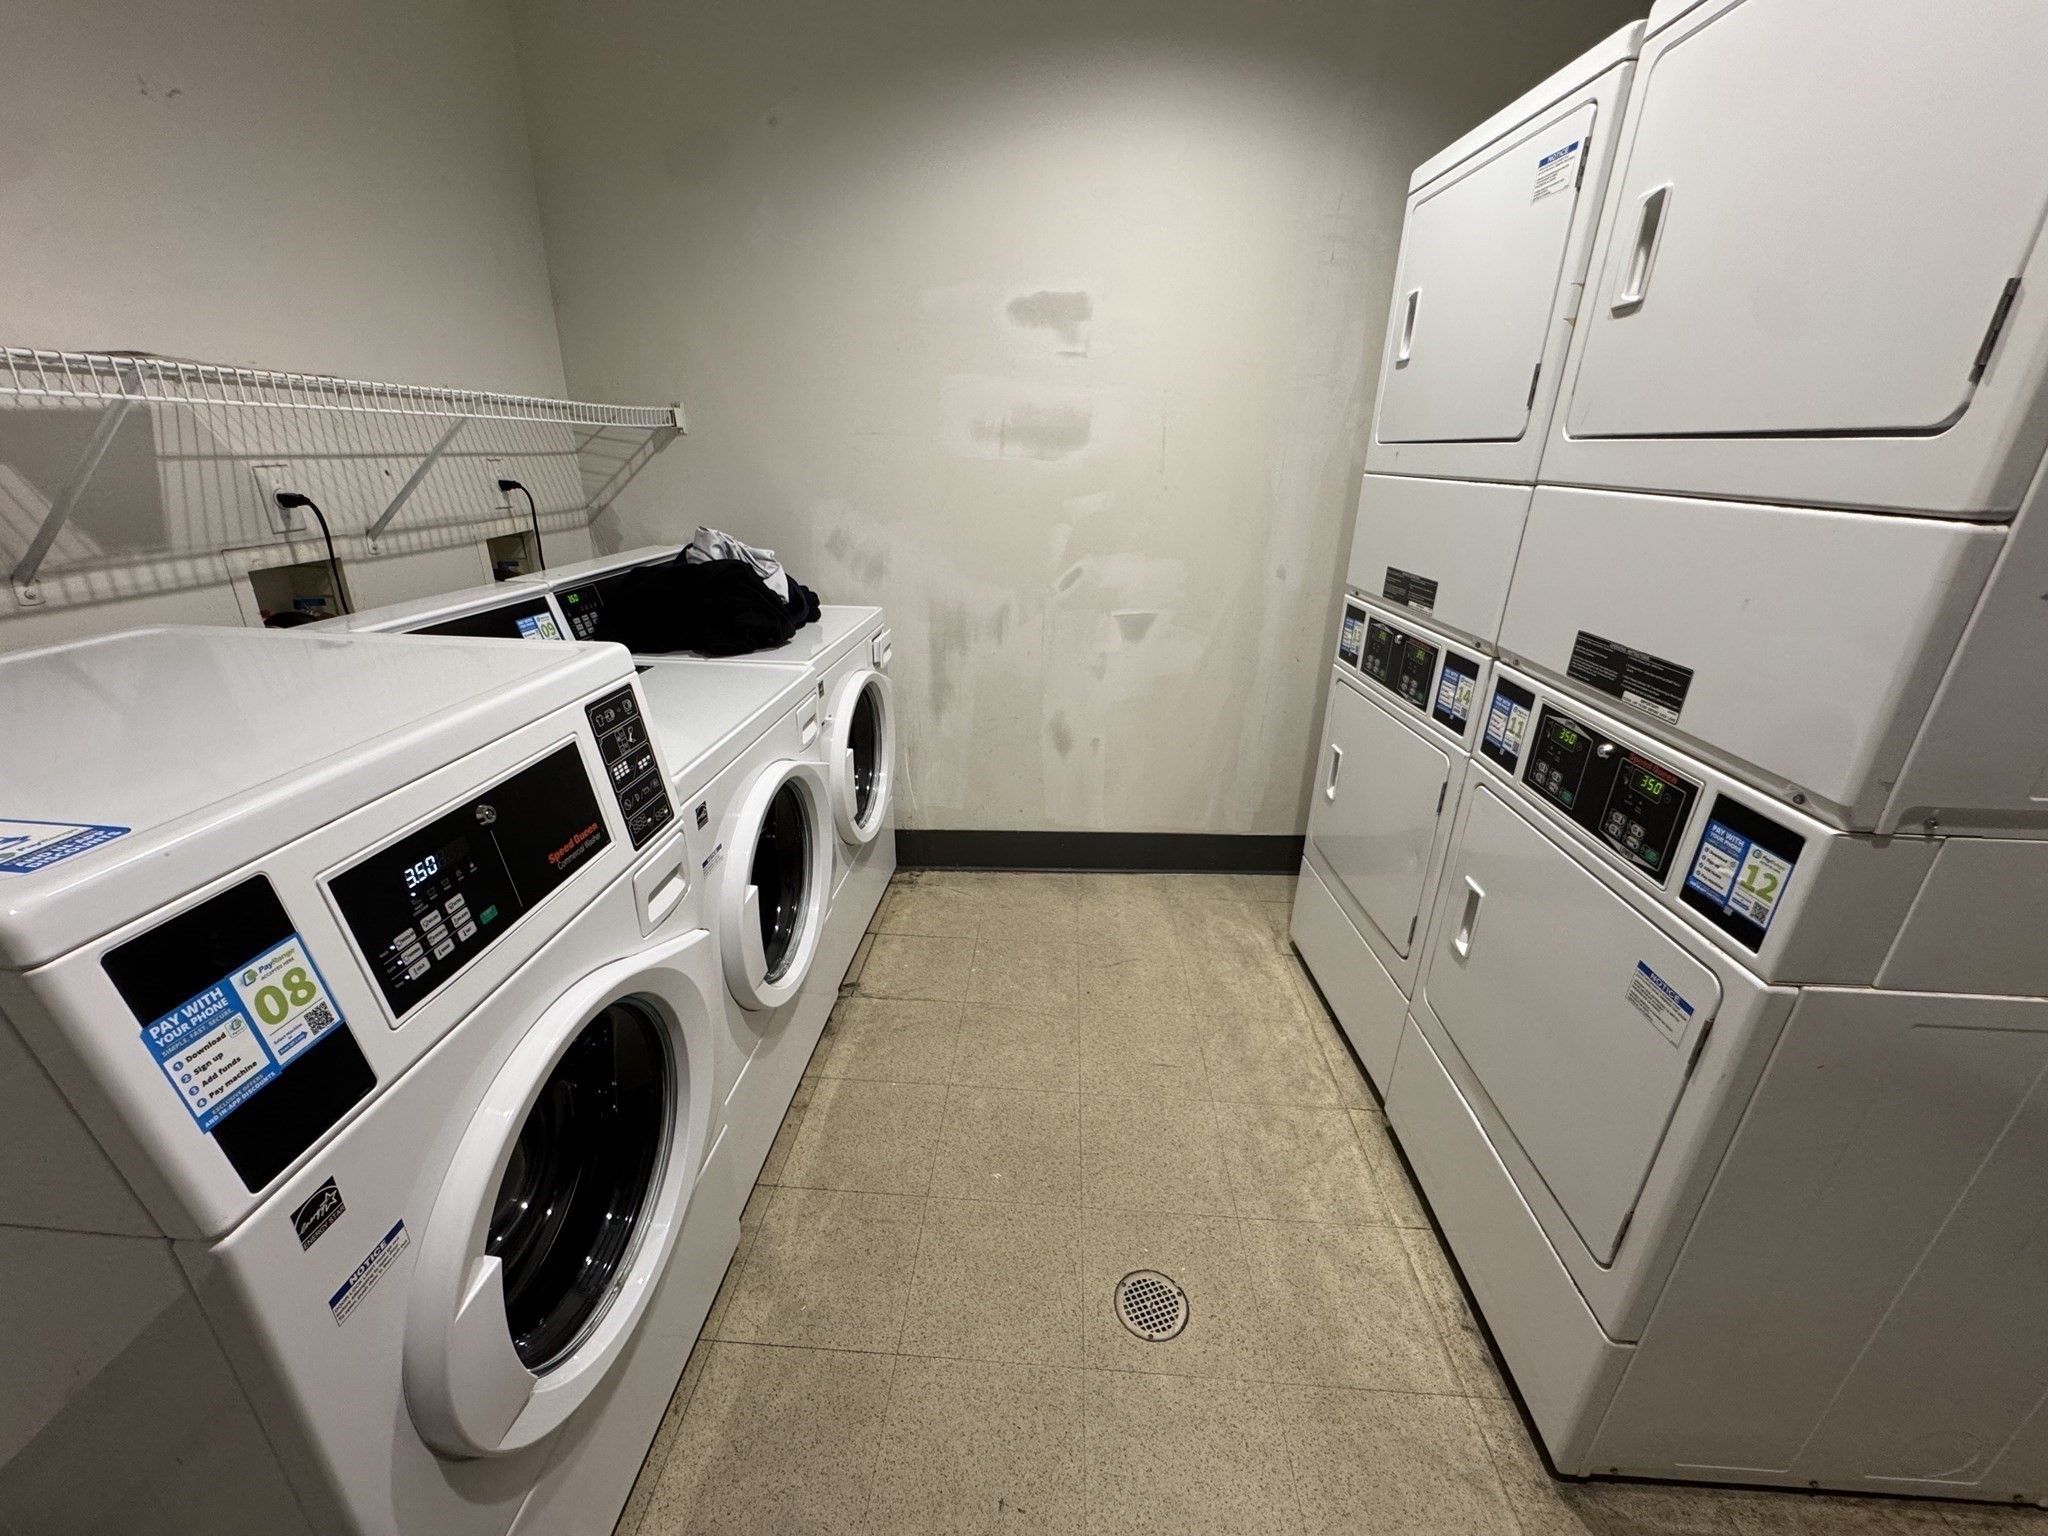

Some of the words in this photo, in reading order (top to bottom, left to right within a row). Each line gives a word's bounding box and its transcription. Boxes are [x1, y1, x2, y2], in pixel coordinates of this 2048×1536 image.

[540, 622, 556, 638] 09
[1454, 687, 1471, 705] 14
[1507, 717, 1524, 739] 11
[1559, 728, 1577, 745] 350
[1640, 775, 1663, 795] 350
[548, 838, 575, 864] Speed
[573, 822, 598, 844] Queen
[1711, 824, 1726, 836] PAY
[1726, 832, 1745, 847] WITH
[1739, 864, 1778, 903] 12
[258, 948, 295, 973] PayRange
[261, 964, 283, 980] ACCEPTED
[283, 957, 295, 967] HERE
[254, 967, 316, 1025] 08
[1650, 973, 1681, 1004] NOTICE
[149, 1012, 180, 1039] PAY
[181, 987, 224, 1018] WITH
[155, 1022, 191, 1047] YOUR
[190, 997, 229, 1026] PHONE
[185, 1032, 226, 1063] Download
[193, 1060, 212, 1076] Sign
[212, 1052, 224, 1062] up
[202, 1072, 218, 1087] Add
[218, 1057, 242, 1075] funds
[209, 1085, 224, 1099] Pay
[225, 1061, 257, 1087] machine
[211, 1088, 242, 1115] EXCLUSIVE
[242, 1074, 264, 1091] OFFERS
[205, 1115, 219, 1128] AND
[219, 1098, 241, 1116] IN-APP
[241, 1071, 276, 1099] DISCOUNTS
[303, 1222, 328, 1250] ENERGY
[328, 1205, 345, 1224] STAR
[348, 1240, 387, 1286] NOTICE
